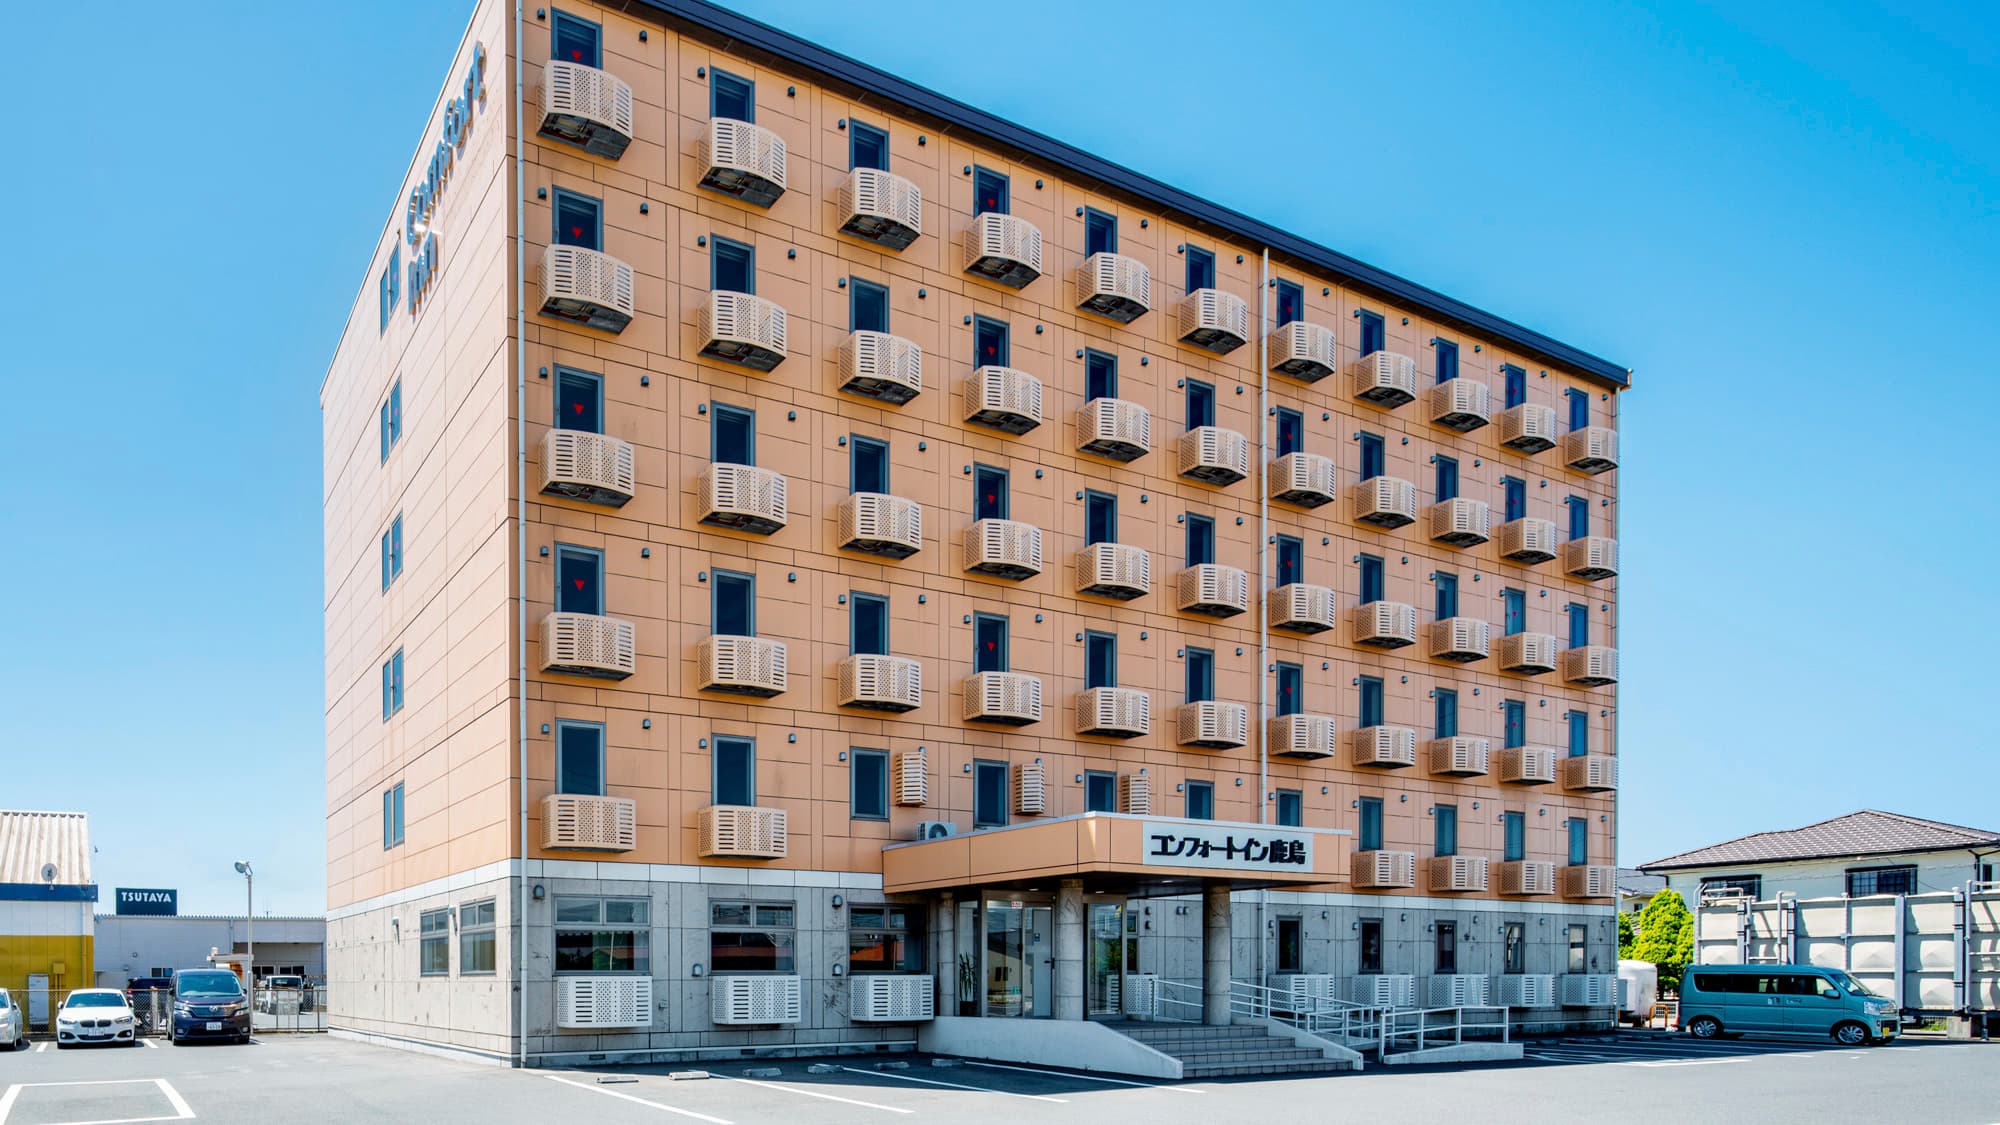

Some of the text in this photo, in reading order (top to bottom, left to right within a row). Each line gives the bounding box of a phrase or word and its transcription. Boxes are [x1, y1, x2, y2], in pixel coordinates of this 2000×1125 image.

[1151, 835, 1307, 865] コンフォートイン鹿島
[121, 891, 172, 903] TSUTAYA
